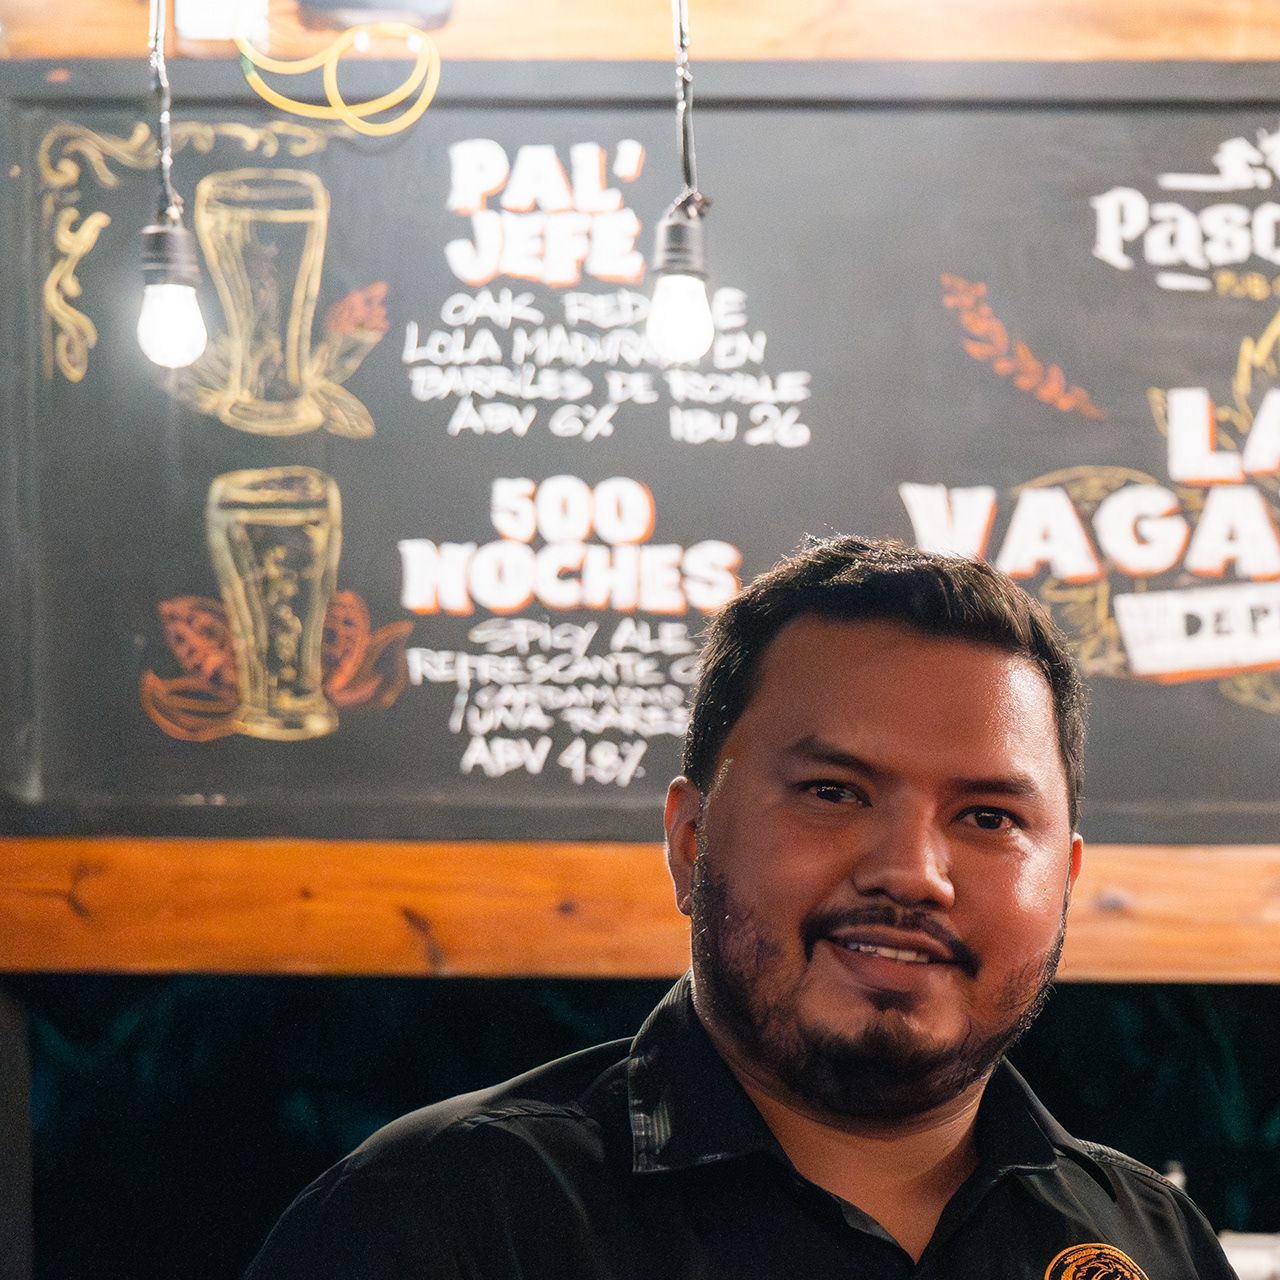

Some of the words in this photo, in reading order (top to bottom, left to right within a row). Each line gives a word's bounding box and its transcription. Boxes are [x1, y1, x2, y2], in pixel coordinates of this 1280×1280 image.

[446, 138, 645, 216] PAL'
[445, 208, 646, 288] JEFE
[440, 288, 545, 328] OAK
[402, 321, 502, 364] LOLA
[606, 371, 658, 404] DE
[447, 397, 537, 437] ABV
[549, 403, 619, 442] 6%
[745, 404, 810, 448] 26
[491, 475, 656, 545] 500
[399, 539, 742, 616] NOCHES
